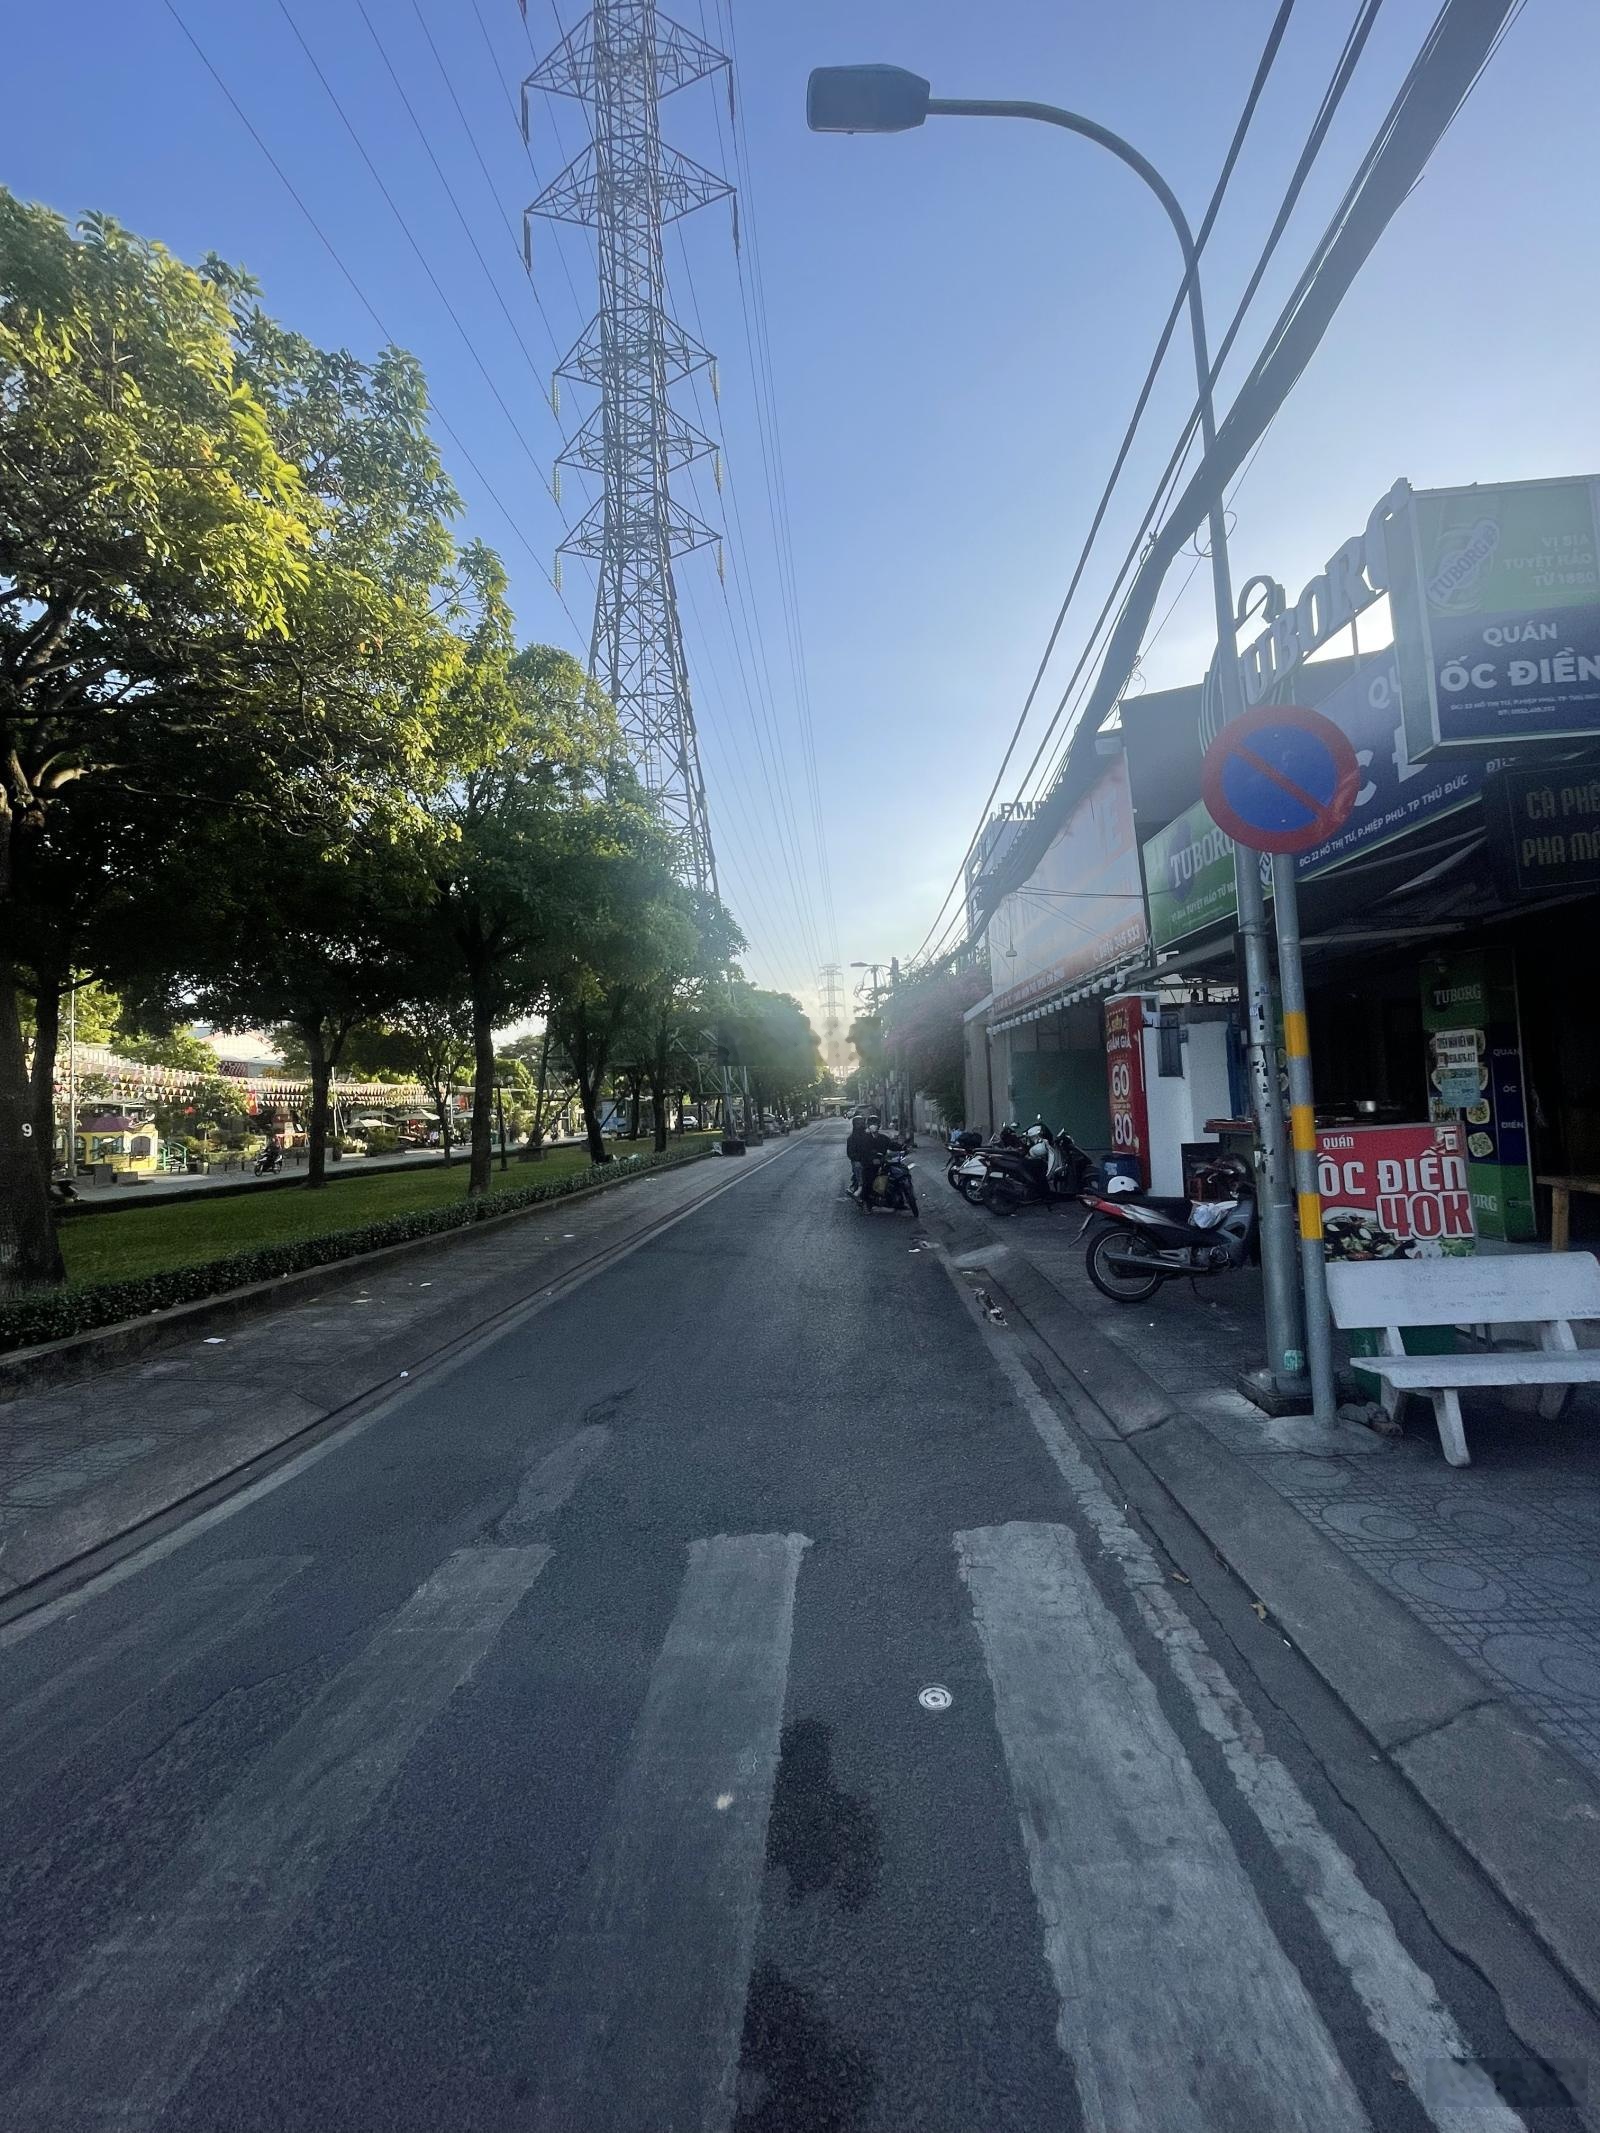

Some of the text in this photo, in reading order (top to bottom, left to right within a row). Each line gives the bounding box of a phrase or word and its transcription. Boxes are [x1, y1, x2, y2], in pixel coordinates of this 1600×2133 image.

[1483, 620, 1558, 647] QUÁN
[1440, 646, 1600, 692] ỐC ĐIỀN
[1521, 835, 1566, 867] PHA
[1433, 984, 1482, 1006] TUBORG
[1112, 1063, 1130, 1097] 60
[21, 1123, 33, 1138] 9
[1114, 1113, 1133, 1146] 80
[1323, 1135, 1354, 1149] QUÁN
[1377, 1146, 1467, 1193] ĐIỀN
[1376, 1191, 1475, 1241] 40K
